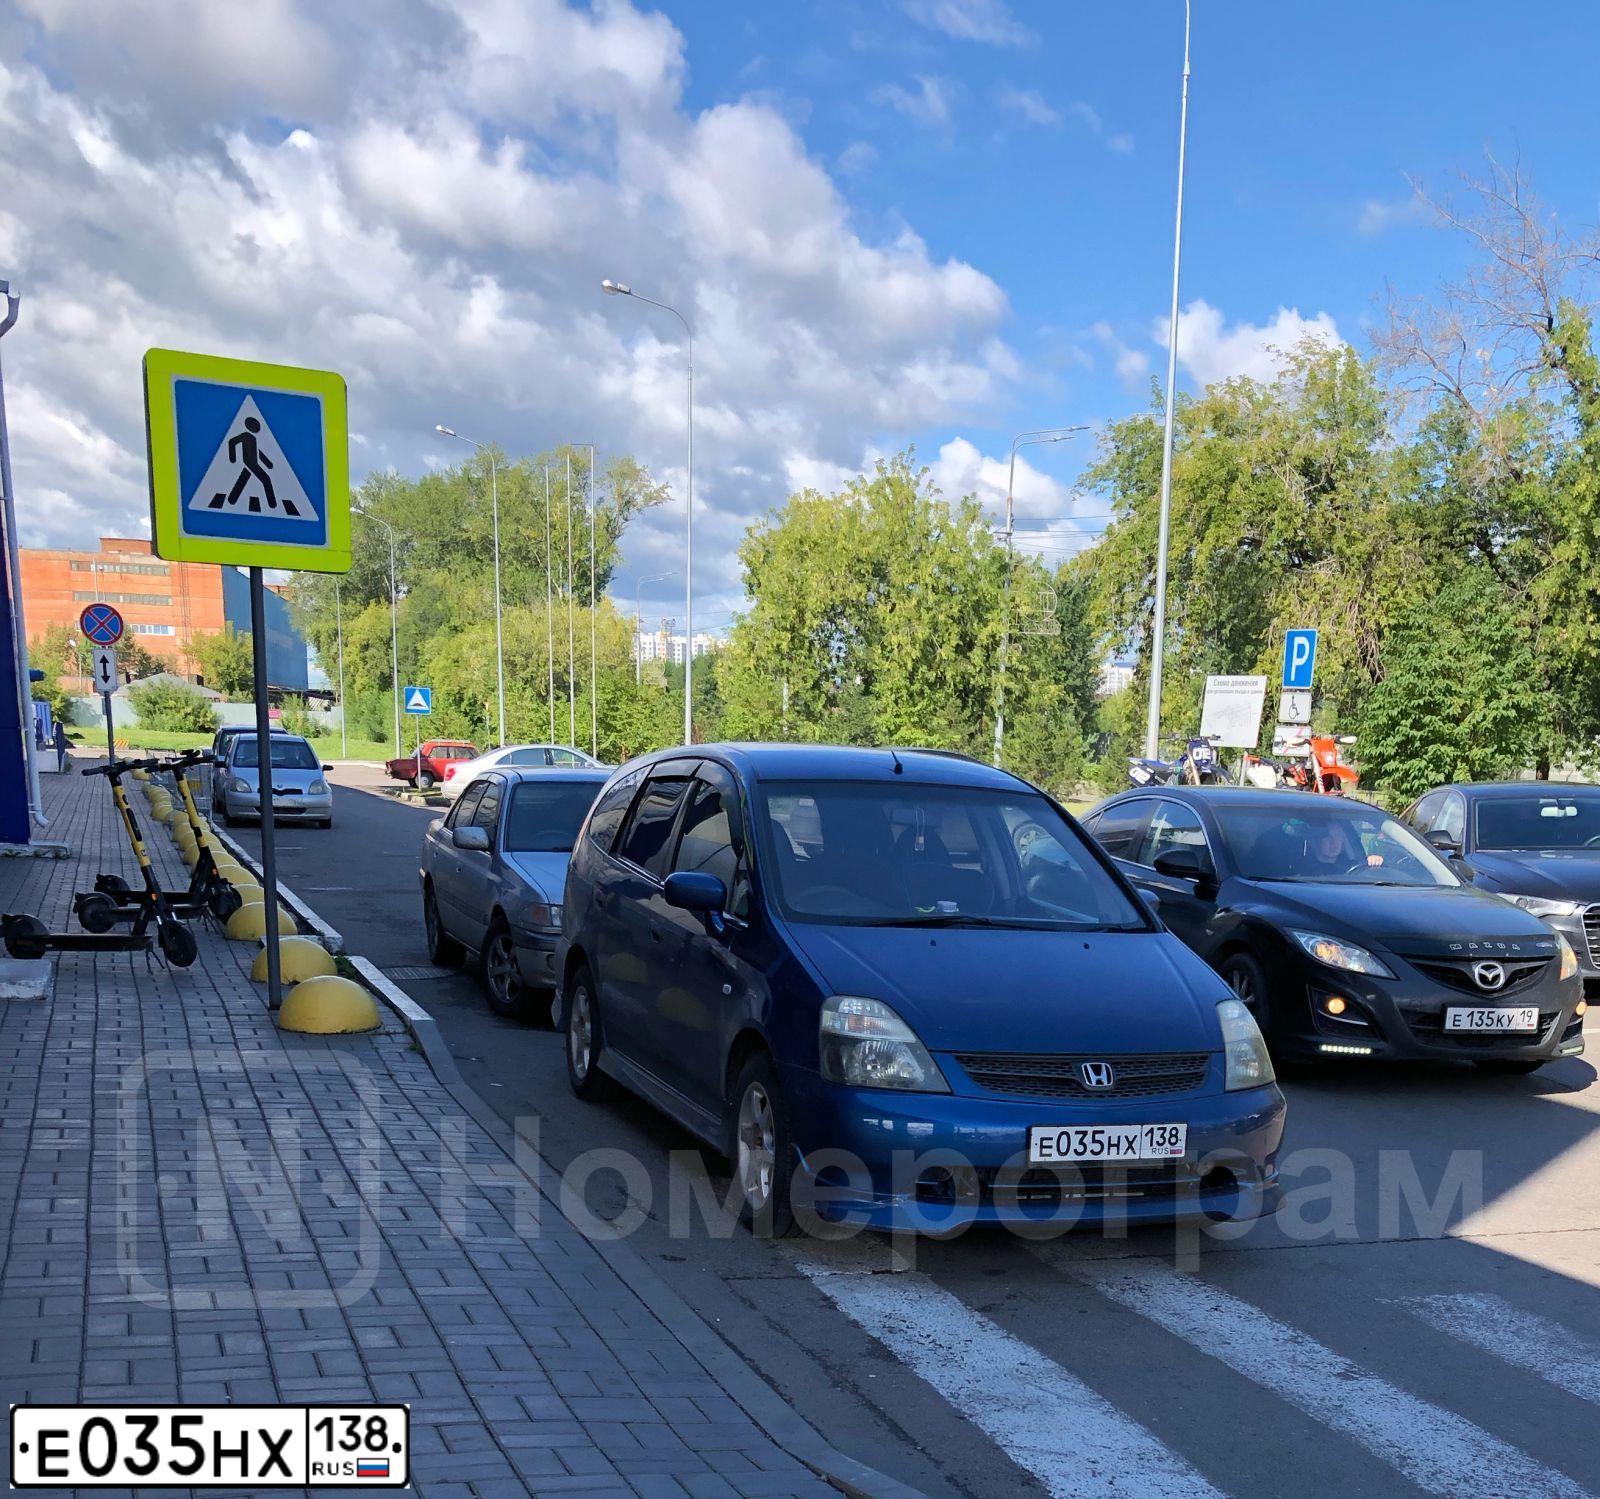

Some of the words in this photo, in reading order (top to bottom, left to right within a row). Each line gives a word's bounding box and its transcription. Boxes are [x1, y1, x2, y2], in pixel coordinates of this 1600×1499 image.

[1291, 636, 1310, 682] P
[1449, 942, 1521, 951] MAZDA
[1520, 1010, 1533, 1023] 19
[1039, 1130, 1138, 1158] Е035НХ
[1144, 1126, 1180, 1147] 138
[1151, 1147, 1169, 1155] RUS
